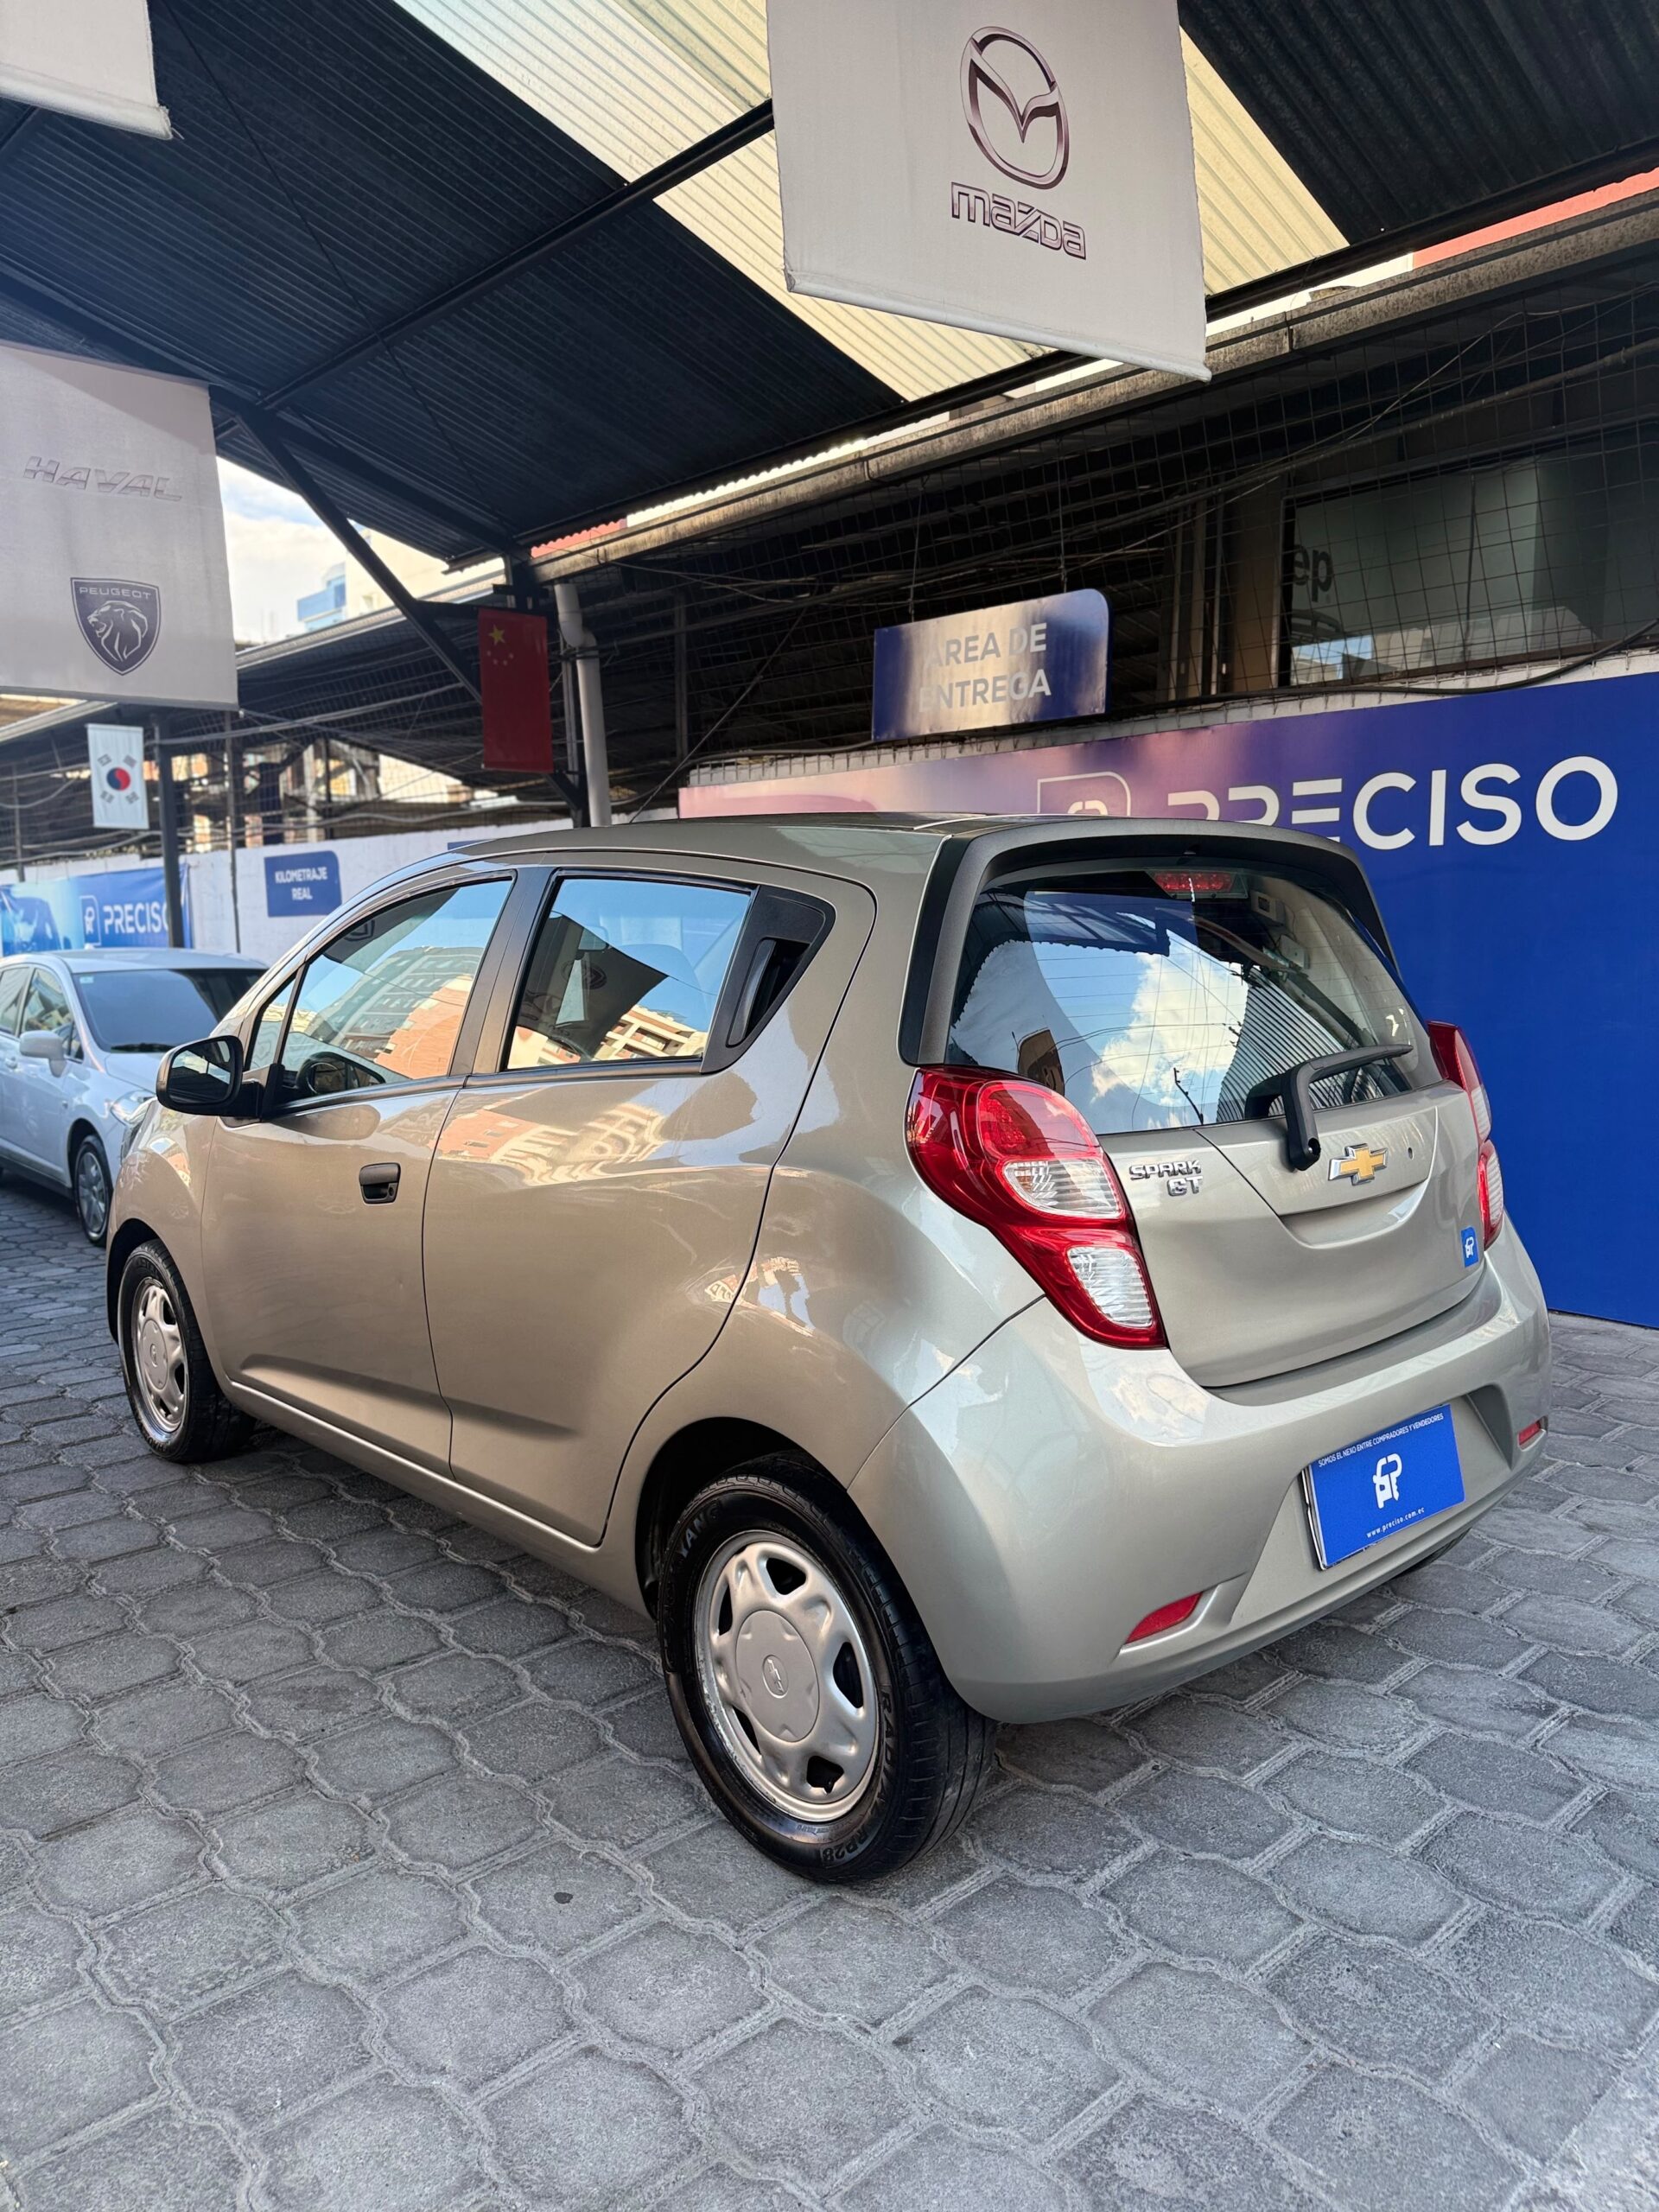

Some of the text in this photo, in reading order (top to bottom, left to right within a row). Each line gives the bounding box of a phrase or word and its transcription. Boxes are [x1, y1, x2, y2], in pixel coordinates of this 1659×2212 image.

[22, 455, 183, 502] HAVAL
[79, 586, 151, 600] PEUGEOT
[1008, 622, 1047, 656] DE
[919, 669, 1052, 713] ENTREGA
[275, 867, 328, 883] KILOMETRAJE
[291, 887, 313, 901] REAL
[1129, 1160, 1202, 1180] SPARK
[1167, 1176, 1203, 1196] GT
[1318, 1454, 1336, 1467] SOMOS
[1343, 1446, 1357, 1458] NEXO
[1357, 1440, 1372, 1452] ENTRE
[1372, 1426, 1408, 1445] COMPRADORES
[1412, 1413, 1444, 1430] VENDEDORES
[1366, 1507, 1425, 1538] www.preciso.com.ec
